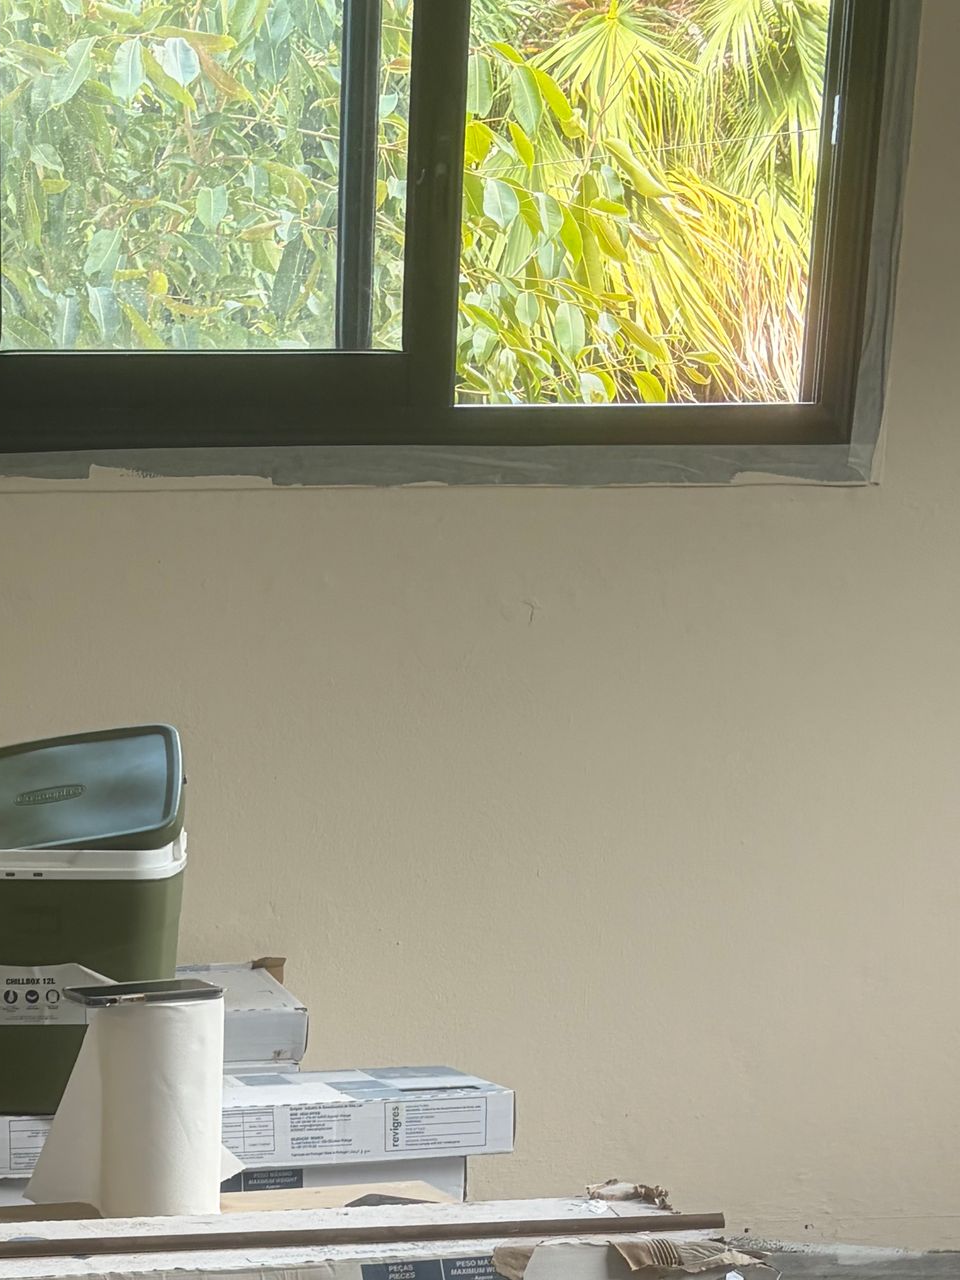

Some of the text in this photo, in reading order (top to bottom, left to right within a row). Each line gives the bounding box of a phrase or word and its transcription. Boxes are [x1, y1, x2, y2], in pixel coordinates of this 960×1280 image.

[5, 977, 56, 986] CHILLBOX 12L
[389, 1105, 402, 1147] revigres
[388, 1264, 414, 1272] PEÇAS
[456, 1260, 476, 1268] PESO
[450, 1267, 485, 1276] MAXIMUM
[388, 1272, 416, 1280] PIECES
